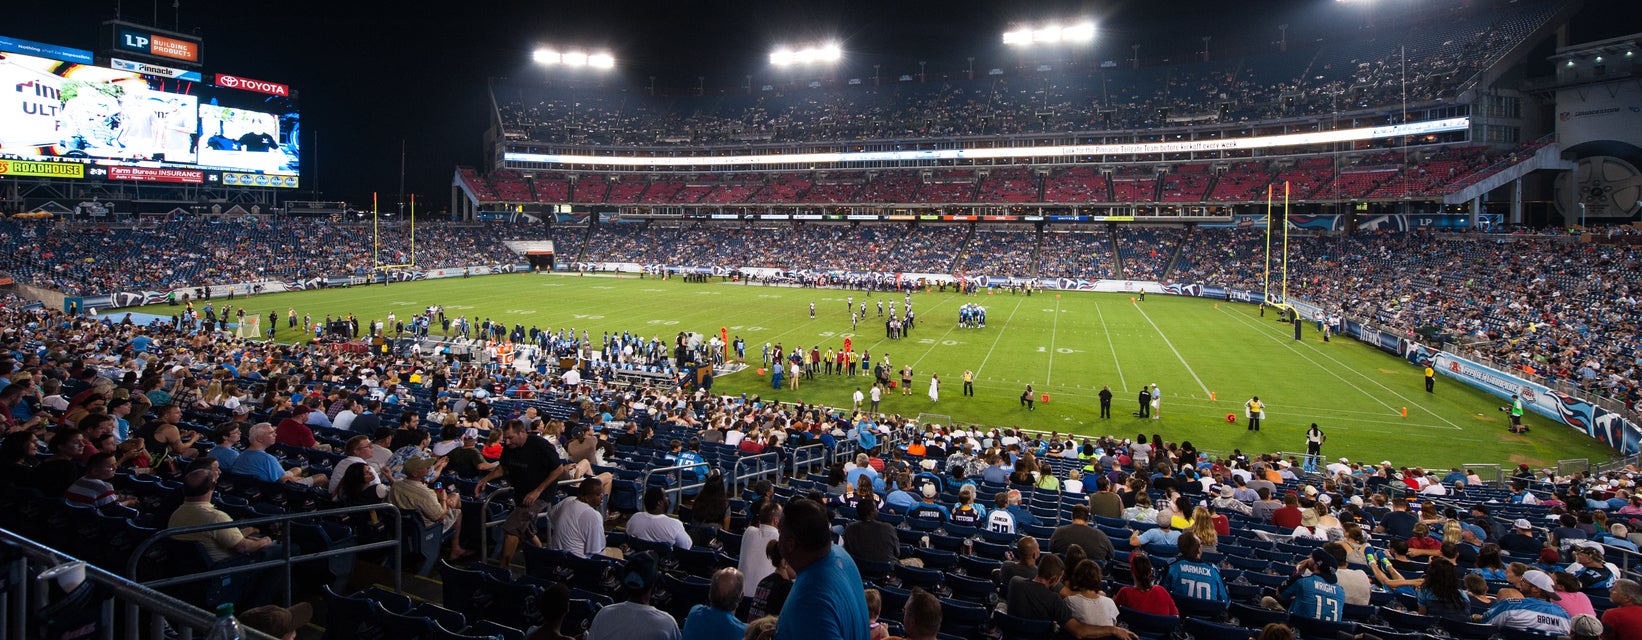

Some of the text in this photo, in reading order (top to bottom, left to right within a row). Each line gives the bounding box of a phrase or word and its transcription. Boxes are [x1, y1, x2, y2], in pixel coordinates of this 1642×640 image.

[125, 34, 148, 48] LP
[154, 40, 187, 50] BUILDING
[154, 45, 191, 57] PRODUCTS
[138, 64, 173, 76] Pinnacle
[240, 79, 284, 94] TOYOTA
[13, 162, 80, 175] ROADHOUSE
[159, 169, 200, 177] INSURANCE
[1180, 564, 1211, 576] WARMACK
[1181, 578, 1210, 600] 70
[1314, 580, 1336, 594] WRIGHT
[1315, 594, 1338, 621] 13
[1537, 615, 1560, 627] BROWN
